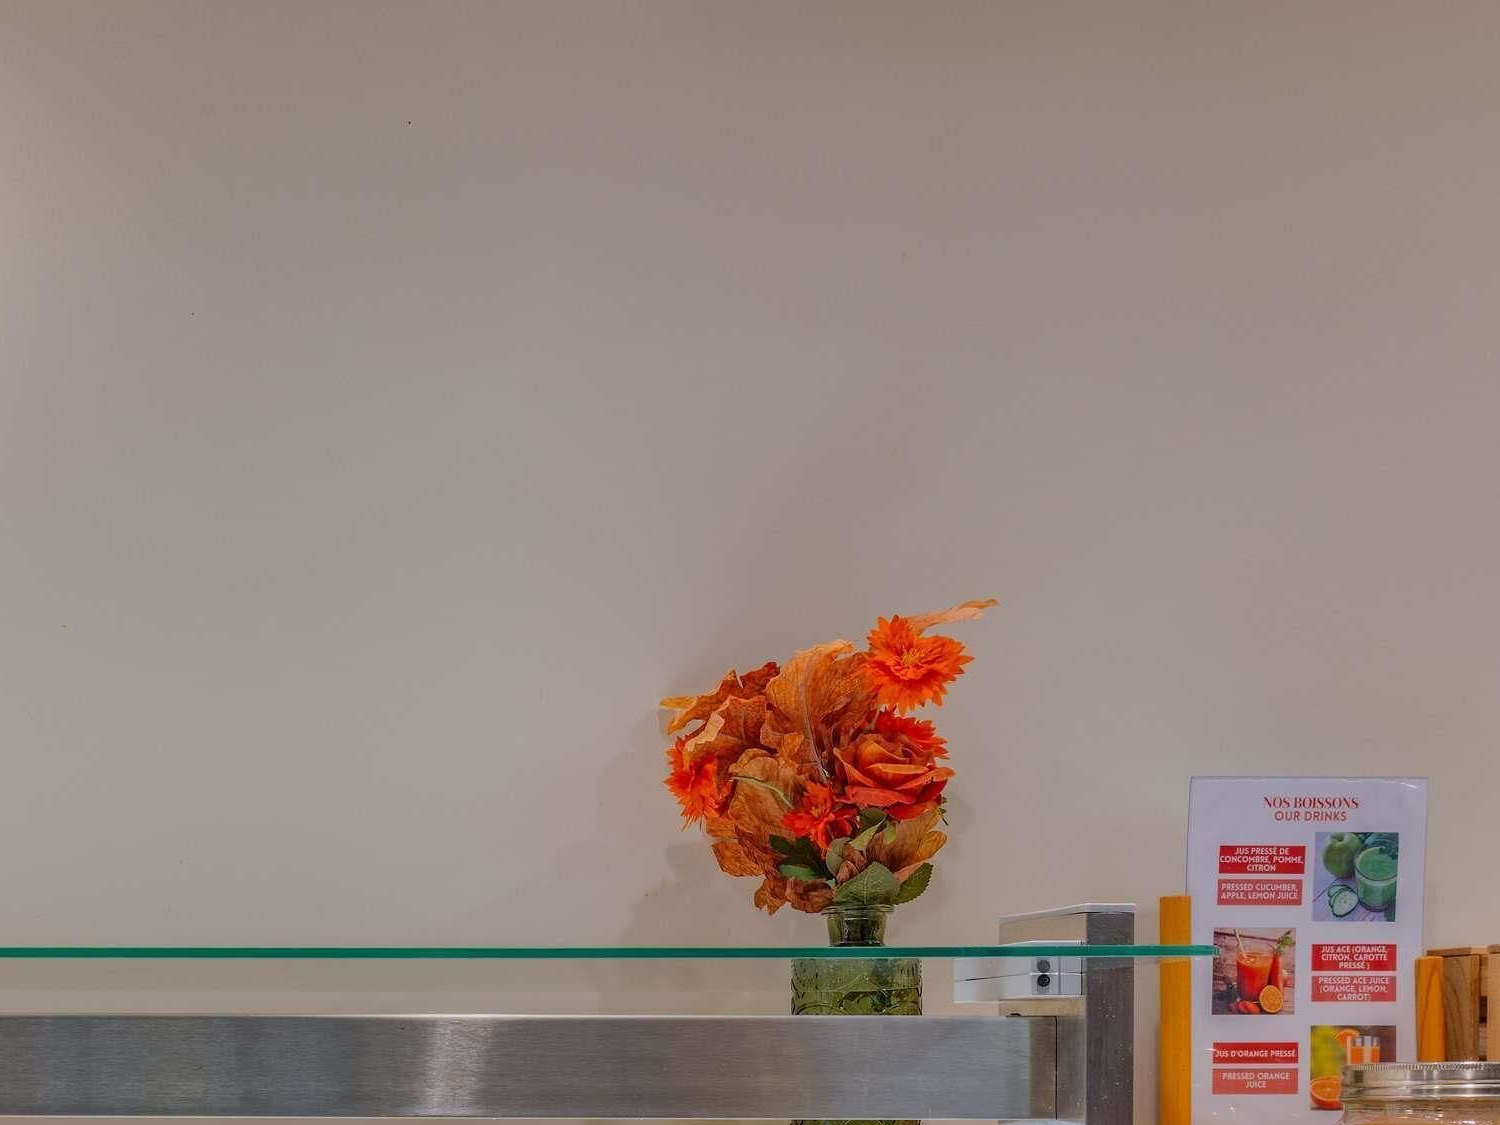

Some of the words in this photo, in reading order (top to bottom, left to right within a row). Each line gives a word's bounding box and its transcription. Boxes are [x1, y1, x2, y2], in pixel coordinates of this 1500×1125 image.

[1263, 796, 1291, 809] NOS
[1293, 796, 1360, 809] BOISSONS
[1274, 810, 1301, 822] OUR
[1304, 810, 1348, 822] DRINKS
[1235, 847, 1249, 855] JUS
[1279, 847, 1290, 855] DE
[1219, 855, 1272, 864] CONCOMBRE,
[1273, 855, 1304, 864] POMME,
[1247, 864, 1276, 872] CITRON
[1221, 883, 1254, 891] PRESSED
[1248, 891, 1275, 900] LEMON
[1277, 891, 1299, 900] JUICE
[1321, 946, 1334, 954] JUS
[1336, 946, 1351, 954] ACE
[1353, 953, 1388, 962] CAROTTE
[1318, 976, 1350, 985] PRESSED
[1352, 976, 1367, 985] ACE
[1368, 976, 1390, 985] JUICE
[1215, 1050, 1229, 1058] JUS
[1230, 1050, 1269, 1058] D'ORANGE
[1222, 1072, 1255, 1080] PRESSED
[1257, 1072, 1290, 1080] ORANGE
[1245, 1080, 1267, 1089] JUICE
